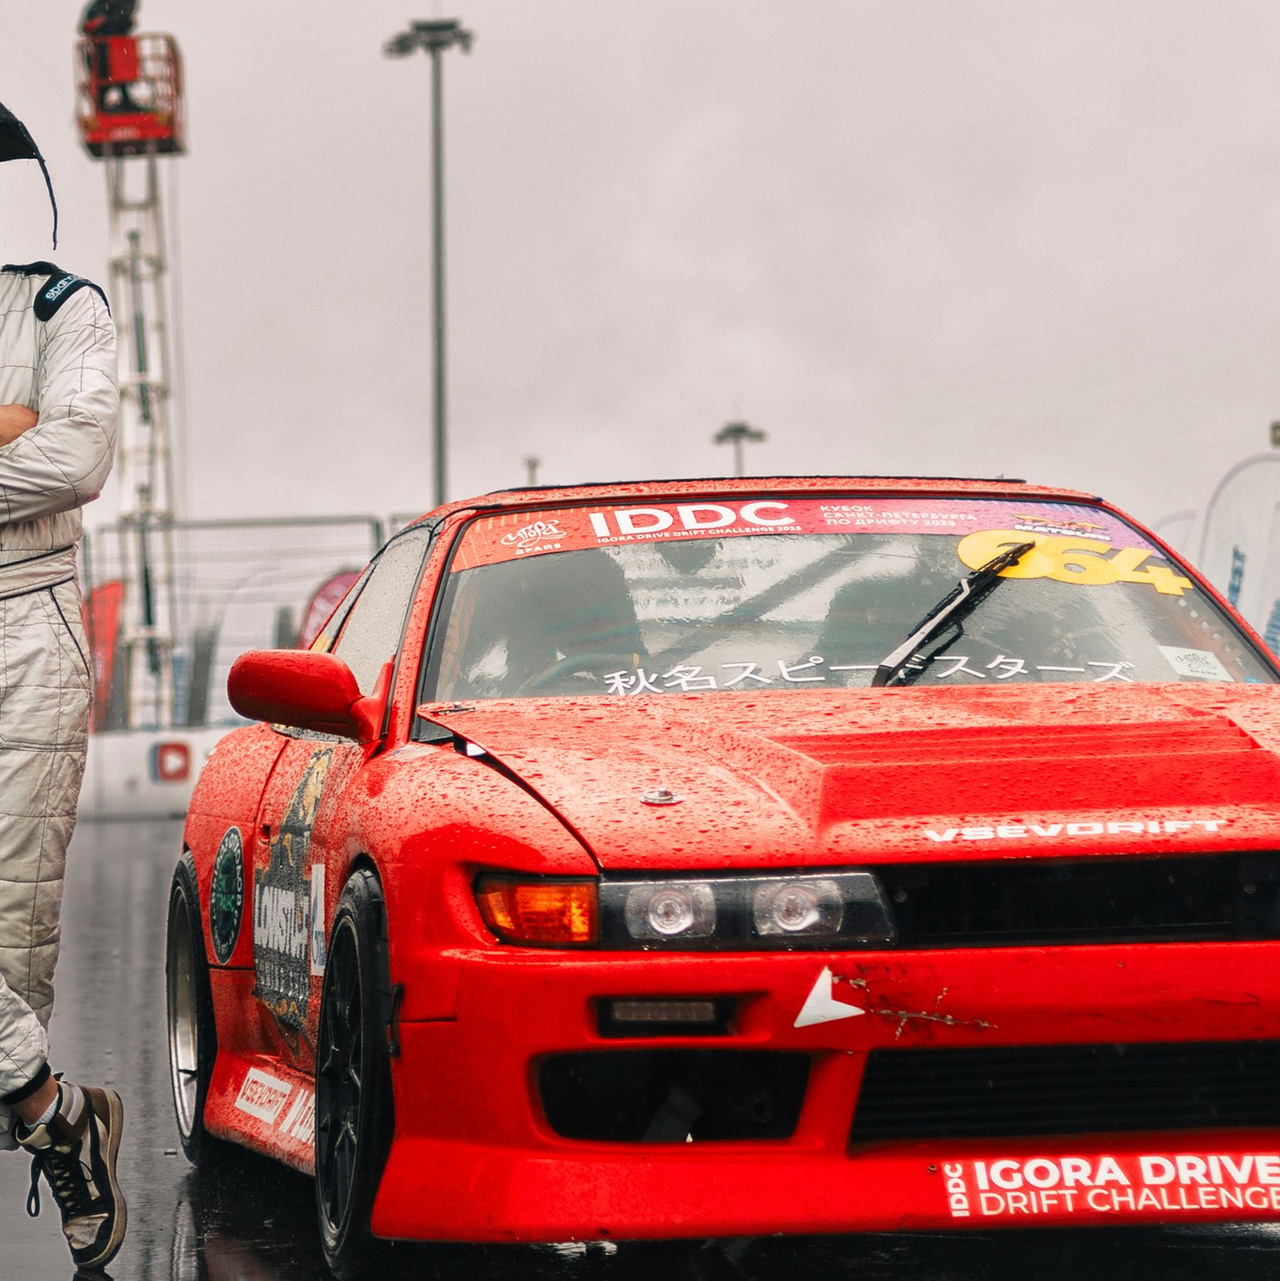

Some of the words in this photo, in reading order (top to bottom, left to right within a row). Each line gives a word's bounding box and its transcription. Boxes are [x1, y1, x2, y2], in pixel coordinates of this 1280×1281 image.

[588, 502, 796, 537] IDDC
[823, 512, 978, 521] САНКТ-ПЕТЕРБУРГА
[854, 519, 919, 527] ДРИФТУ
[597, 535, 634, 544] IGORA
[637, 531, 670, 540] DRIVE
[673, 529, 706, 537] DRIFT
[709, 526, 775, 535] CHALLENGE
[923, 819, 1227, 843] VSEVDRIFT
[973, 1156, 1131, 1191] IGORA
[1138, 1155, 1280, 1186] DRIVE
[944, 1163, 970, 1217] IDDC
[979, 1189, 1078, 1216] DRIFT
